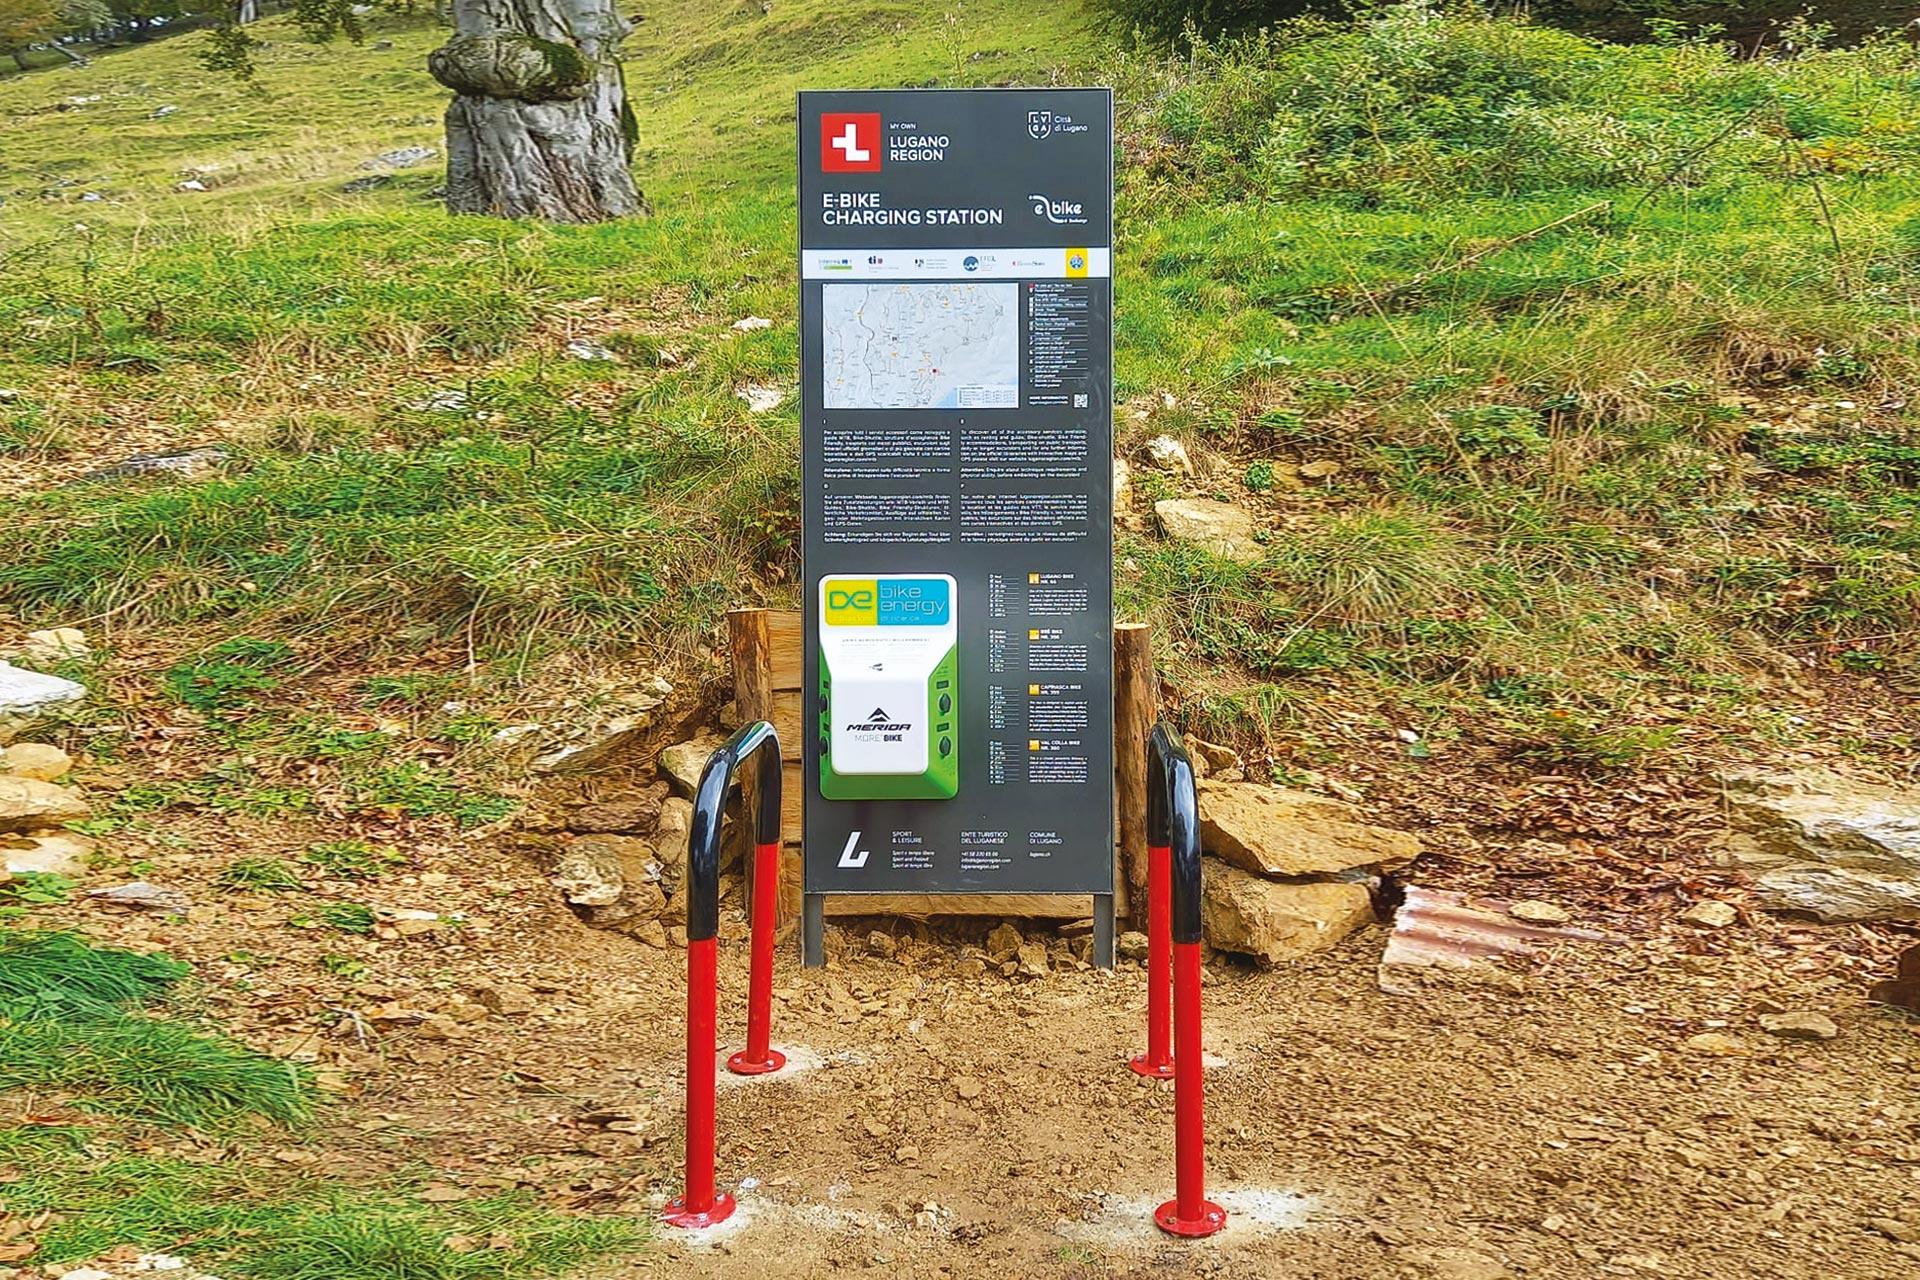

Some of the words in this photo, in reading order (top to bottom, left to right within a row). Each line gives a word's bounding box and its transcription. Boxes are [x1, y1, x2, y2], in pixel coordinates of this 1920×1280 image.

[1062, 124, 1088, 133] Lugano
[890, 136, 949, 148] LUGANO
[890, 150, 943, 161] REGION
[823, 193, 880, 208] E-BIKE
[823, 210, 921, 225] CHARGING
[926, 210, 1003, 225] STATION
[880, 585, 921, 599] bike
[880, 600, 946, 615] energy
[846, 723, 912, 732] MERIDA
[883, 734, 903, 742] BIKE
